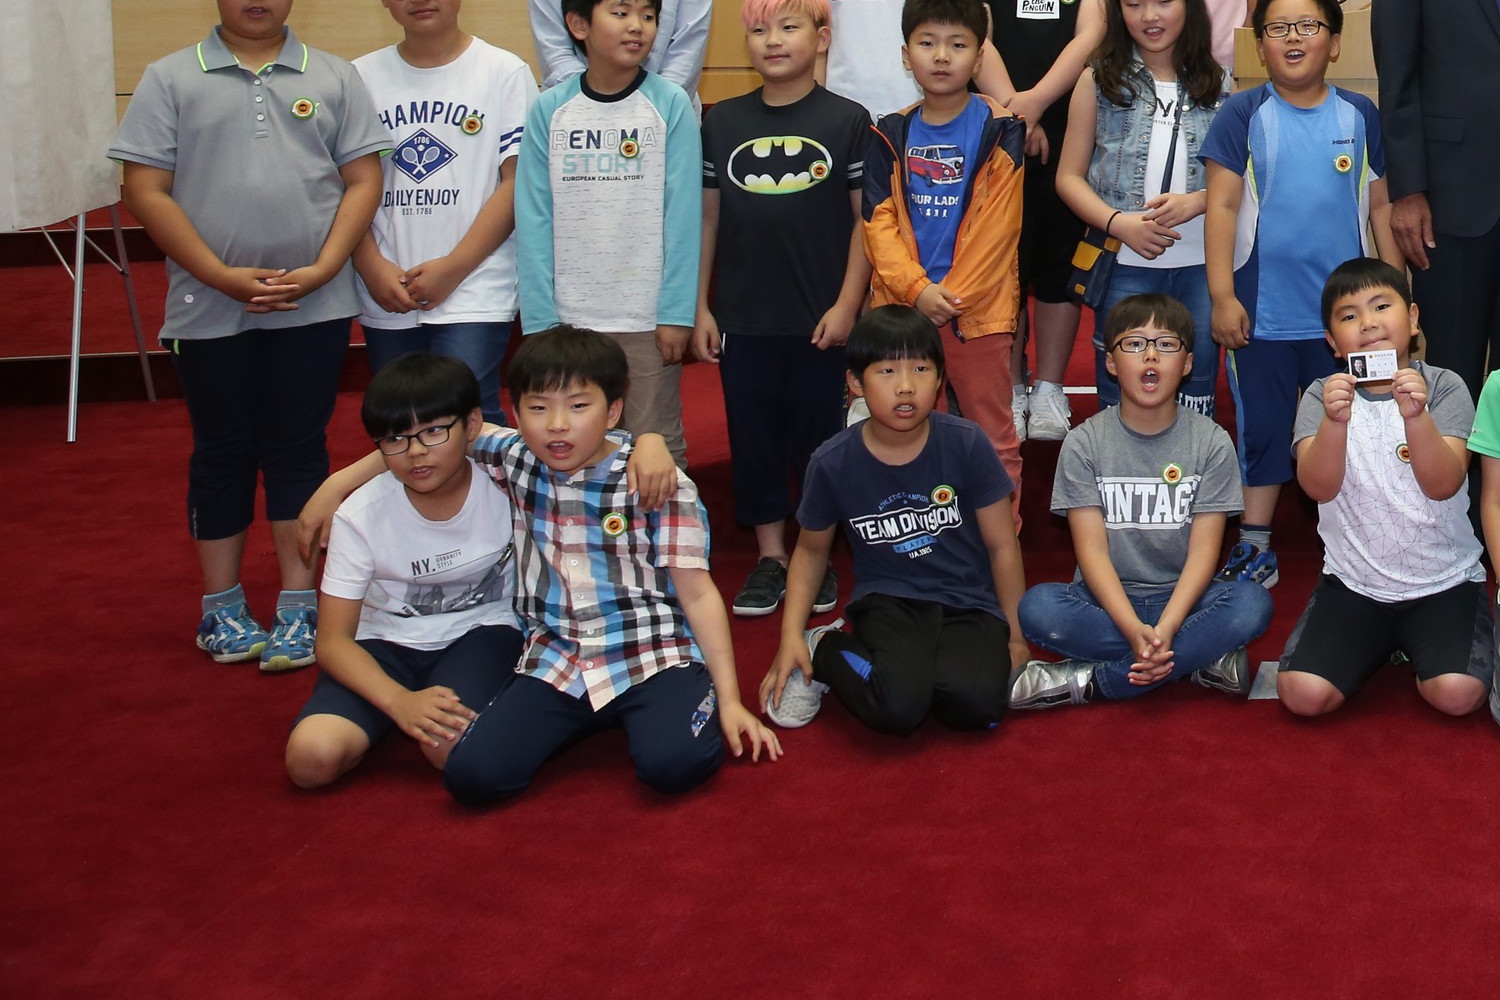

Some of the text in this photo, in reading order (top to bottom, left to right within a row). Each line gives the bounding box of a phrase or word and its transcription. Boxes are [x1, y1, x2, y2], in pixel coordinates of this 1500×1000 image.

[413, 136, 430, 145] 1786
[562, 152, 646, 174] STORY
[415, 189, 460, 206] ENJOY
[402, 208, 415, 216] EST.
[1098, 483, 1197, 523] INTAG
[855, 504, 960, 540] TEAM DIVISION
[437, 560, 453, 569] STYLE
